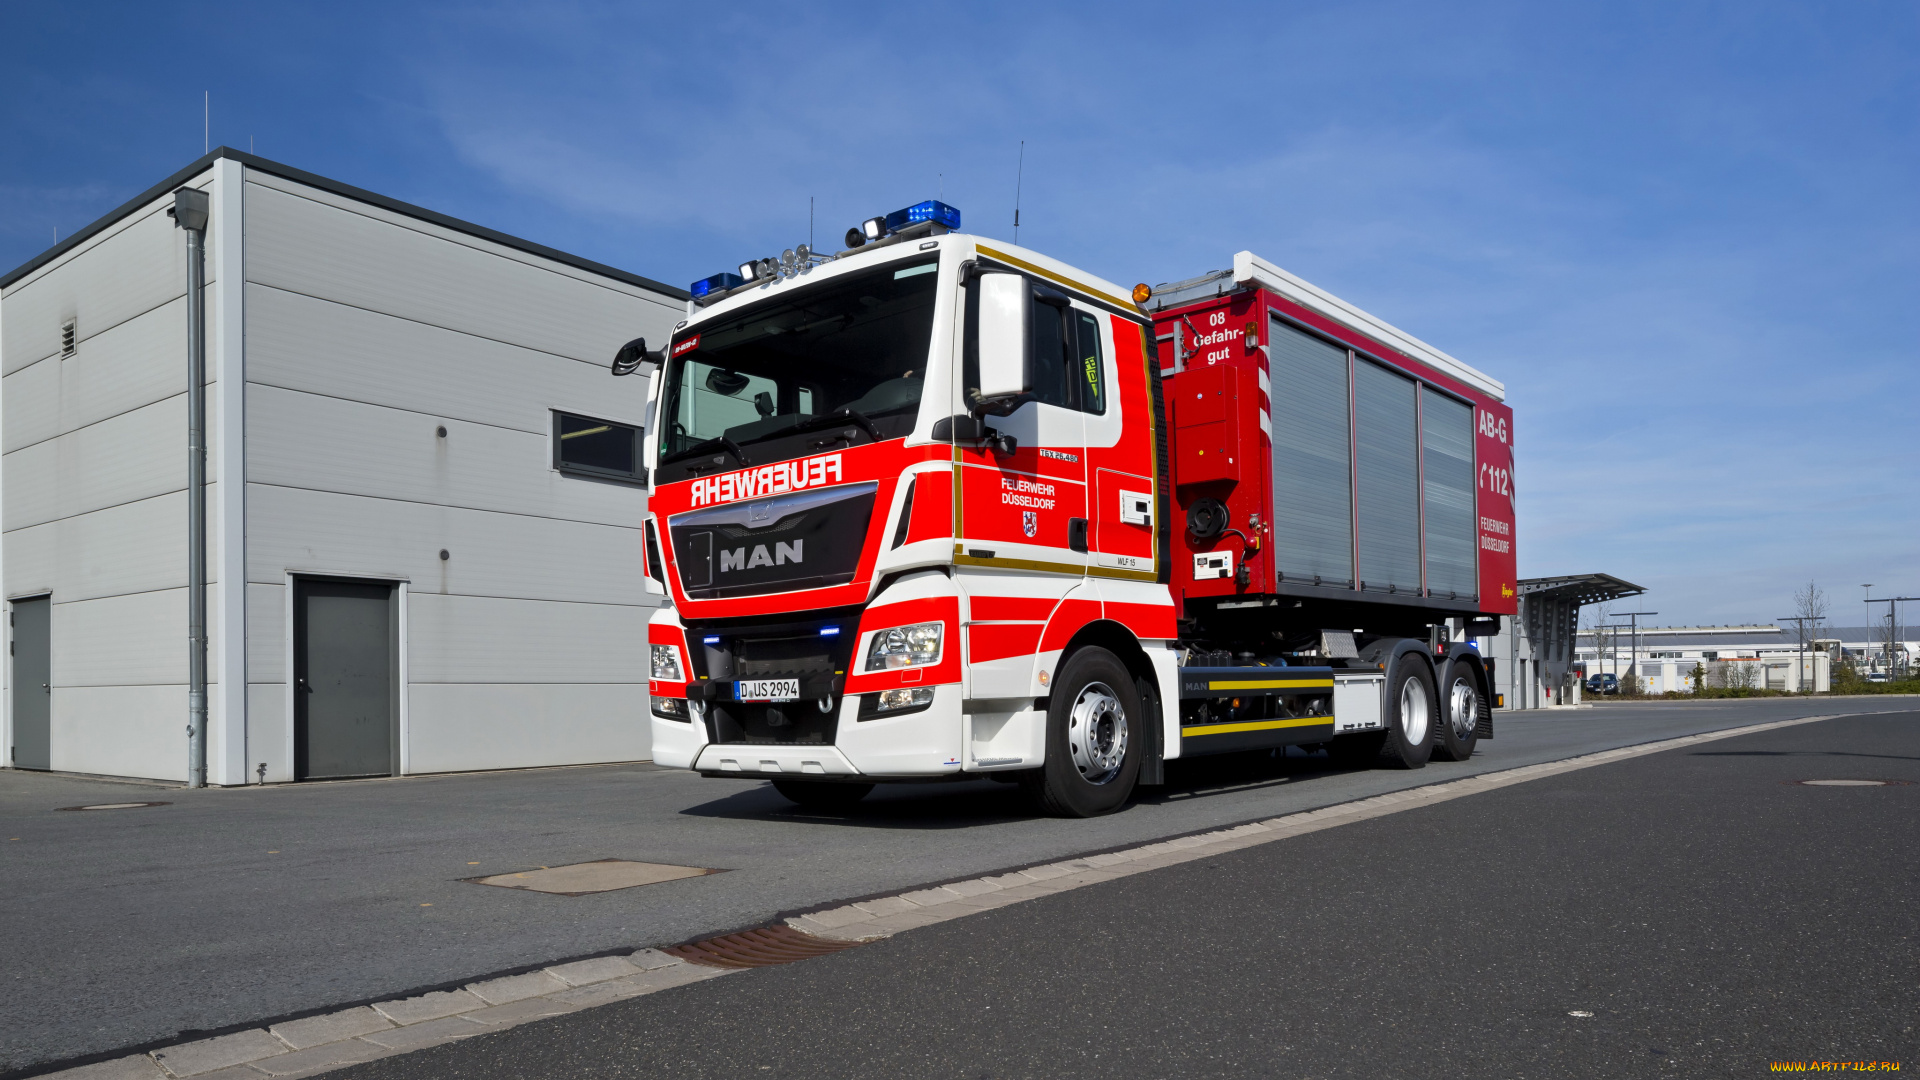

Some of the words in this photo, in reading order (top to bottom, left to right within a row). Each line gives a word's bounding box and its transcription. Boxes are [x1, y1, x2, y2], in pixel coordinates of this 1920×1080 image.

[1209, 312, 1225, 326] 08
[1193, 328, 1244, 347] Gefahr-
[1207, 346, 1230, 365] gut
[1479, 409, 1507, 444] AB-G
[1040, 449, 1054, 458] TGX
[1001, 477, 1055, 496] FEUERWEHR
[1488, 465, 1509, 496] 112
[1001, 491, 1056, 510] DÜSSELDORF
[1480, 516, 1509, 536] FEUERWEHR
[1481, 533, 1510, 554] DÜSSELDORF
[720, 538, 804, 573] MAN
[1117, 557, 1129, 566] WLF
[1130, 558, 1136, 567] 15
[741, 683, 747, 697] D
[754, 682, 768, 697] US
[770, 681, 797, 697] 2994
[1185, 682, 1208, 691] MAN
